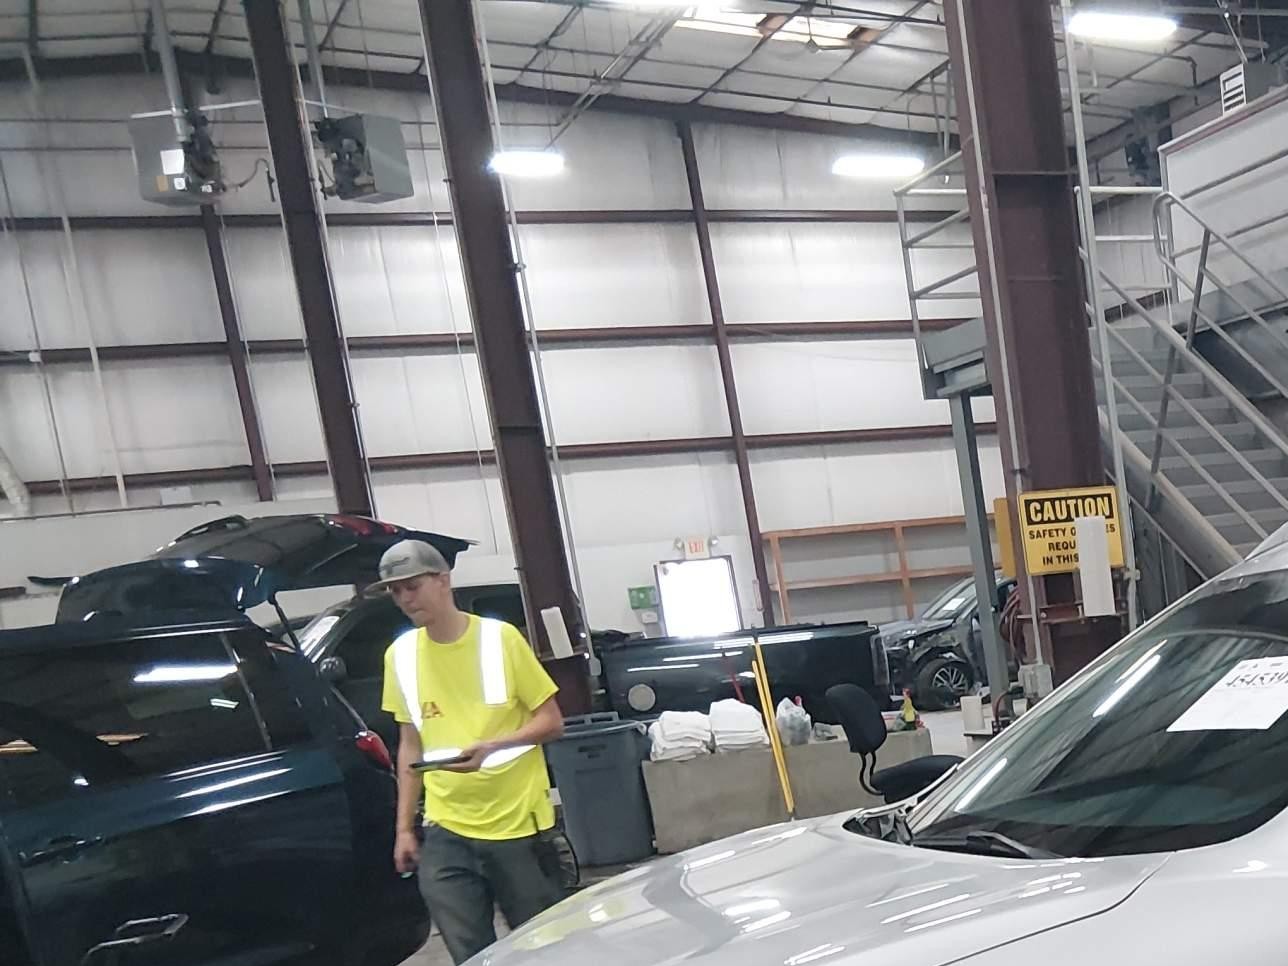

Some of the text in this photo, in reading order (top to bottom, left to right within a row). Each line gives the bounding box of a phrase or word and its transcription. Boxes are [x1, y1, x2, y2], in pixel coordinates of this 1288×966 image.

[1029, 496, 1110, 522] CAUTION
[1028, 527, 1067, 540] SAFETY
[1048, 541, 1076, 552] REQU
[1042, 553, 1079, 566] IN THIS
